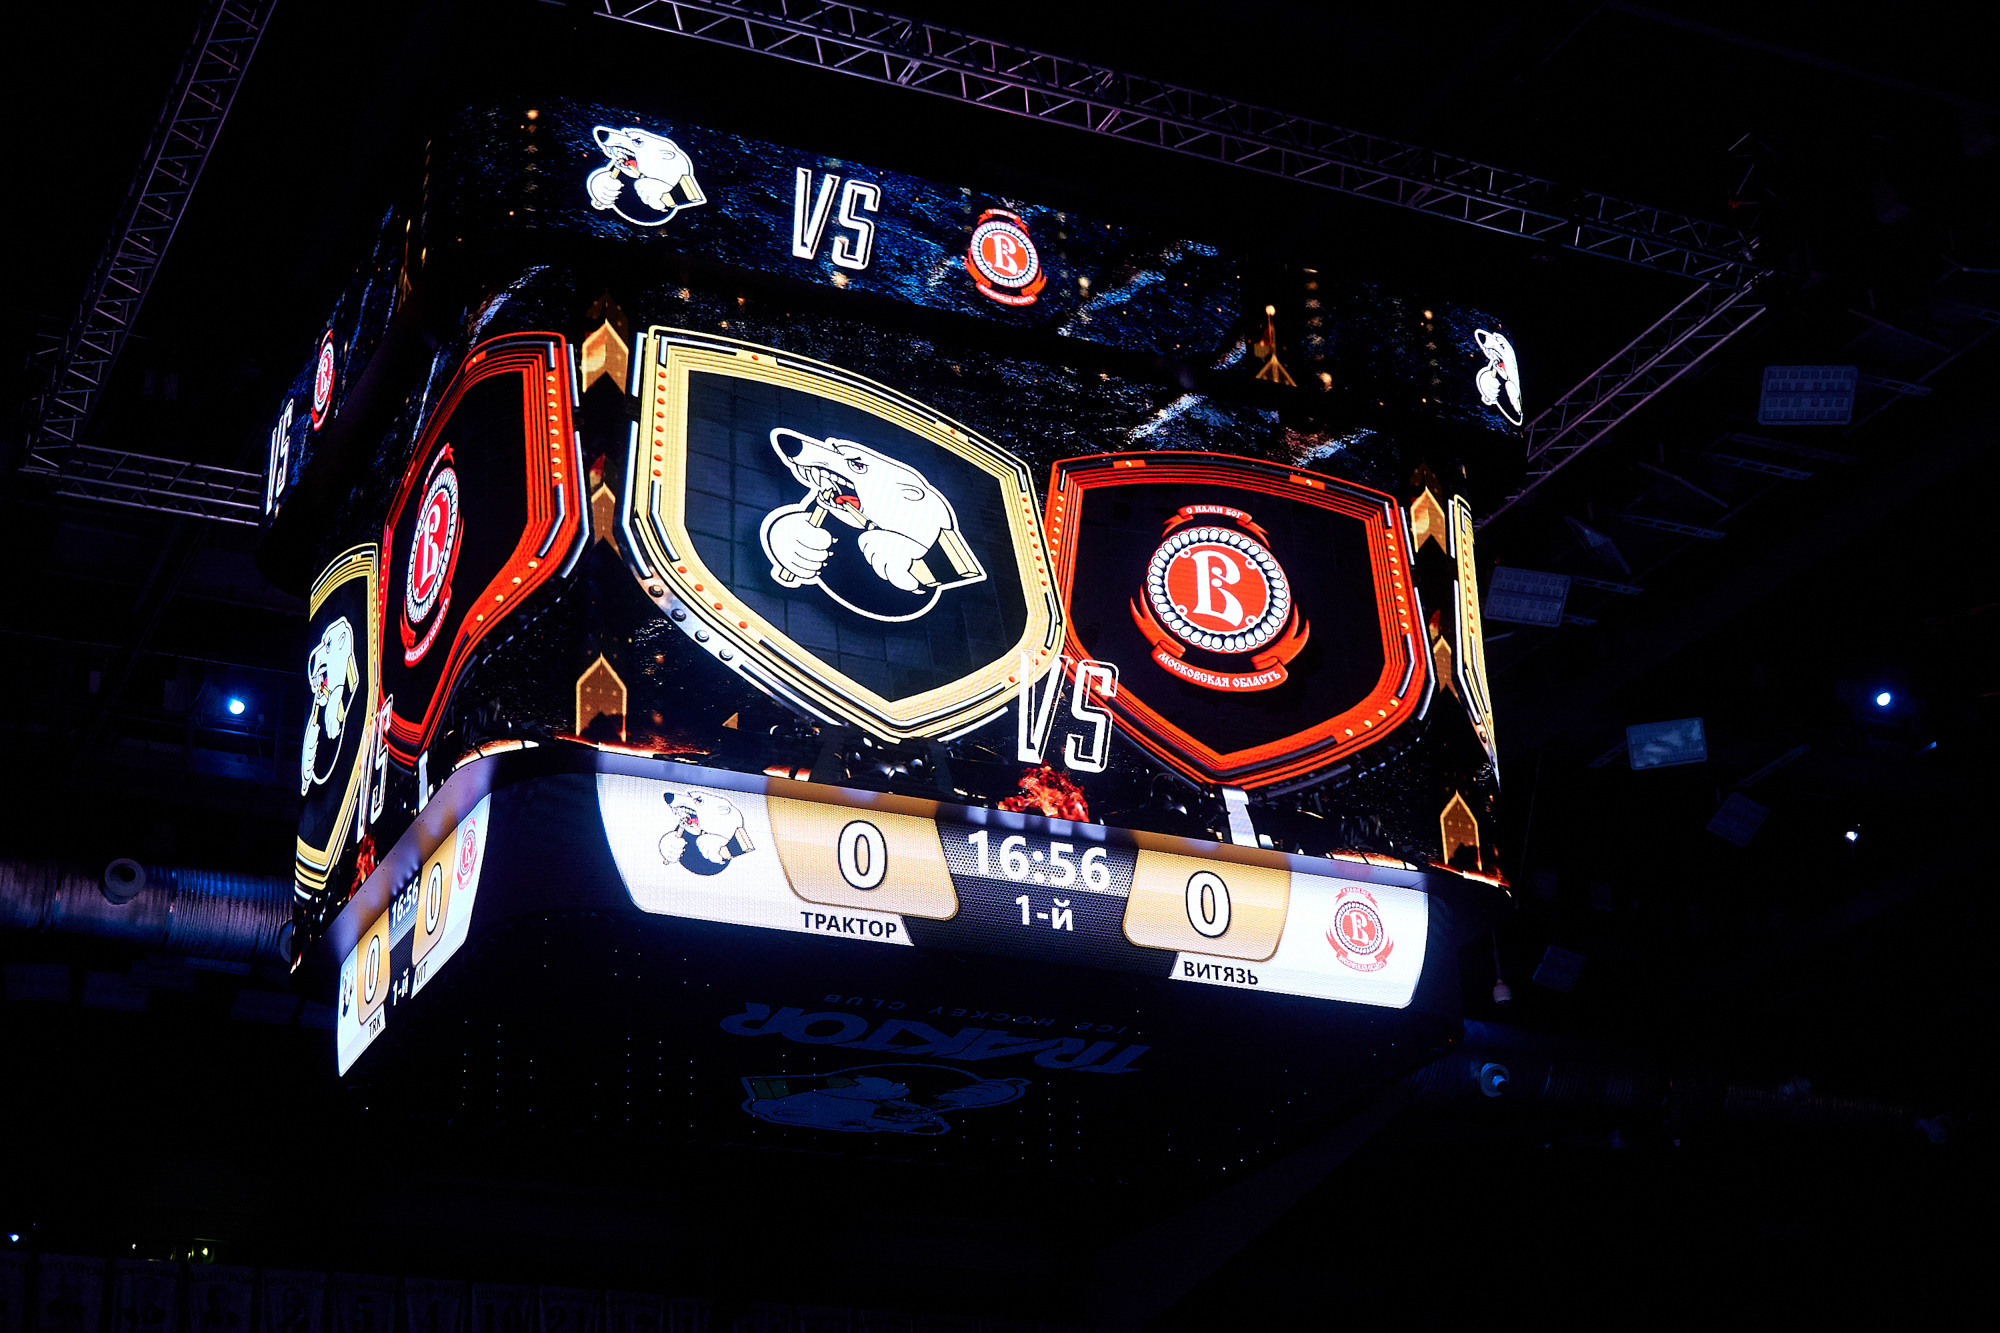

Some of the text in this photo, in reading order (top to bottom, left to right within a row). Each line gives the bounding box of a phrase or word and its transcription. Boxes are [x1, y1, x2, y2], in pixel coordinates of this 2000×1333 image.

[792, 167, 881, 270] VS
[266, 398, 294, 515] VS
[1195, 505, 1223, 514] НАМИ
[1225, 508, 1243, 519] БОГ
[1157, 652, 1282, 687] МОСКОВСКАЯ ОБЛАСТЬ
[1017, 649, 1119, 773] VS
[356, 694, 393, 843] VS
[838, 820, 888, 890] 0
[968, 830, 1111, 892] 16:56
[391, 876, 419, 928] 16:56
[425, 862, 442, 935] 0
[800, 911, 897, 938] ТРАКТОР
[1015, 895, 1073, 931] 1-й
[1185, 870, 1231, 938] 0
[364, 934, 380, 1004] 0
[392, 968, 409, 1006] 1-й
[1183, 960, 1259, 985] ВИТЯЗЬ
[369, 1012, 382, 1038] TRK
[719, 1001, 1152, 1074] TRAKTOR
